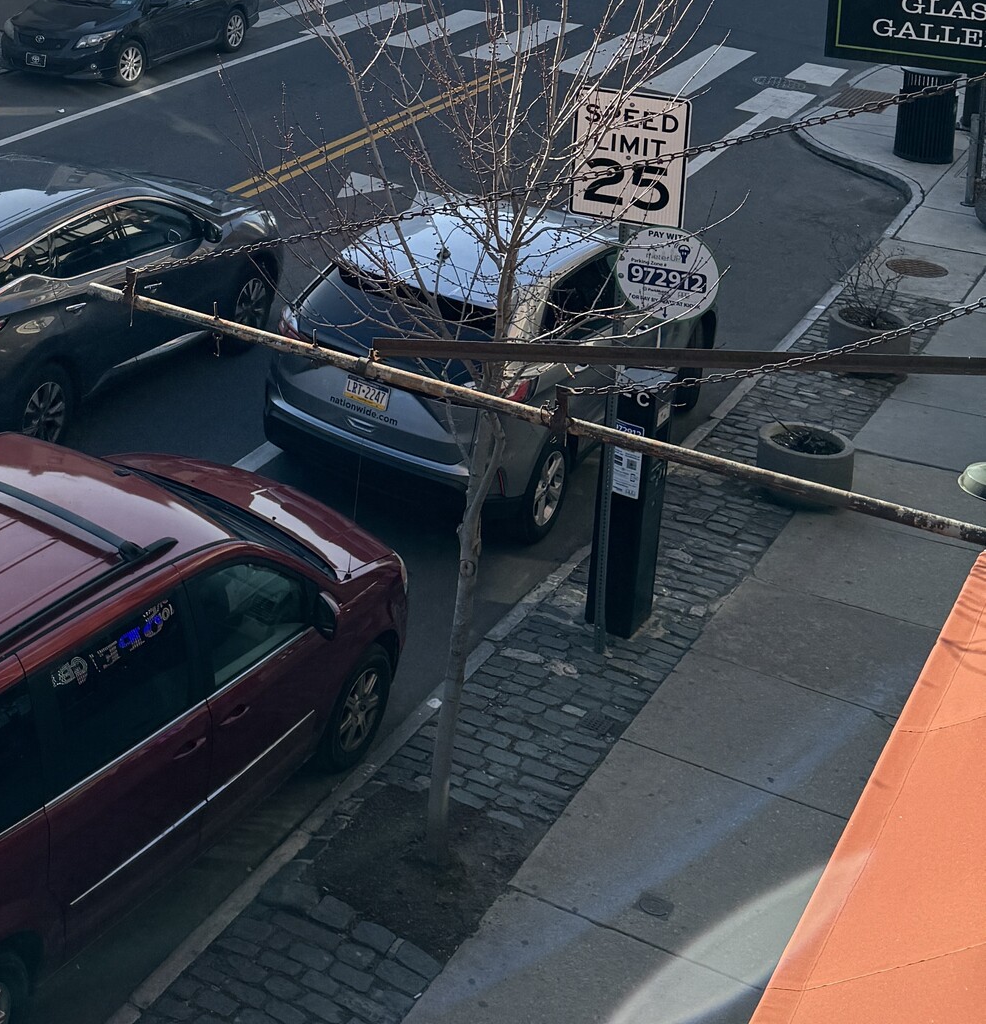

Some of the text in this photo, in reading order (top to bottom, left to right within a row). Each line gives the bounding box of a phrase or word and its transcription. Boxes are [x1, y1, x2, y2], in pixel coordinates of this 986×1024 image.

[872, 18, 986, 48] GALLE
[583, 158, 670, 211] 25
[648, 230, 665, 239] PAY
[630, 257, 650, 265] Parking
[631, 265, 704, 293] 972912
[330, 396, 398, 426] nationwide.com
